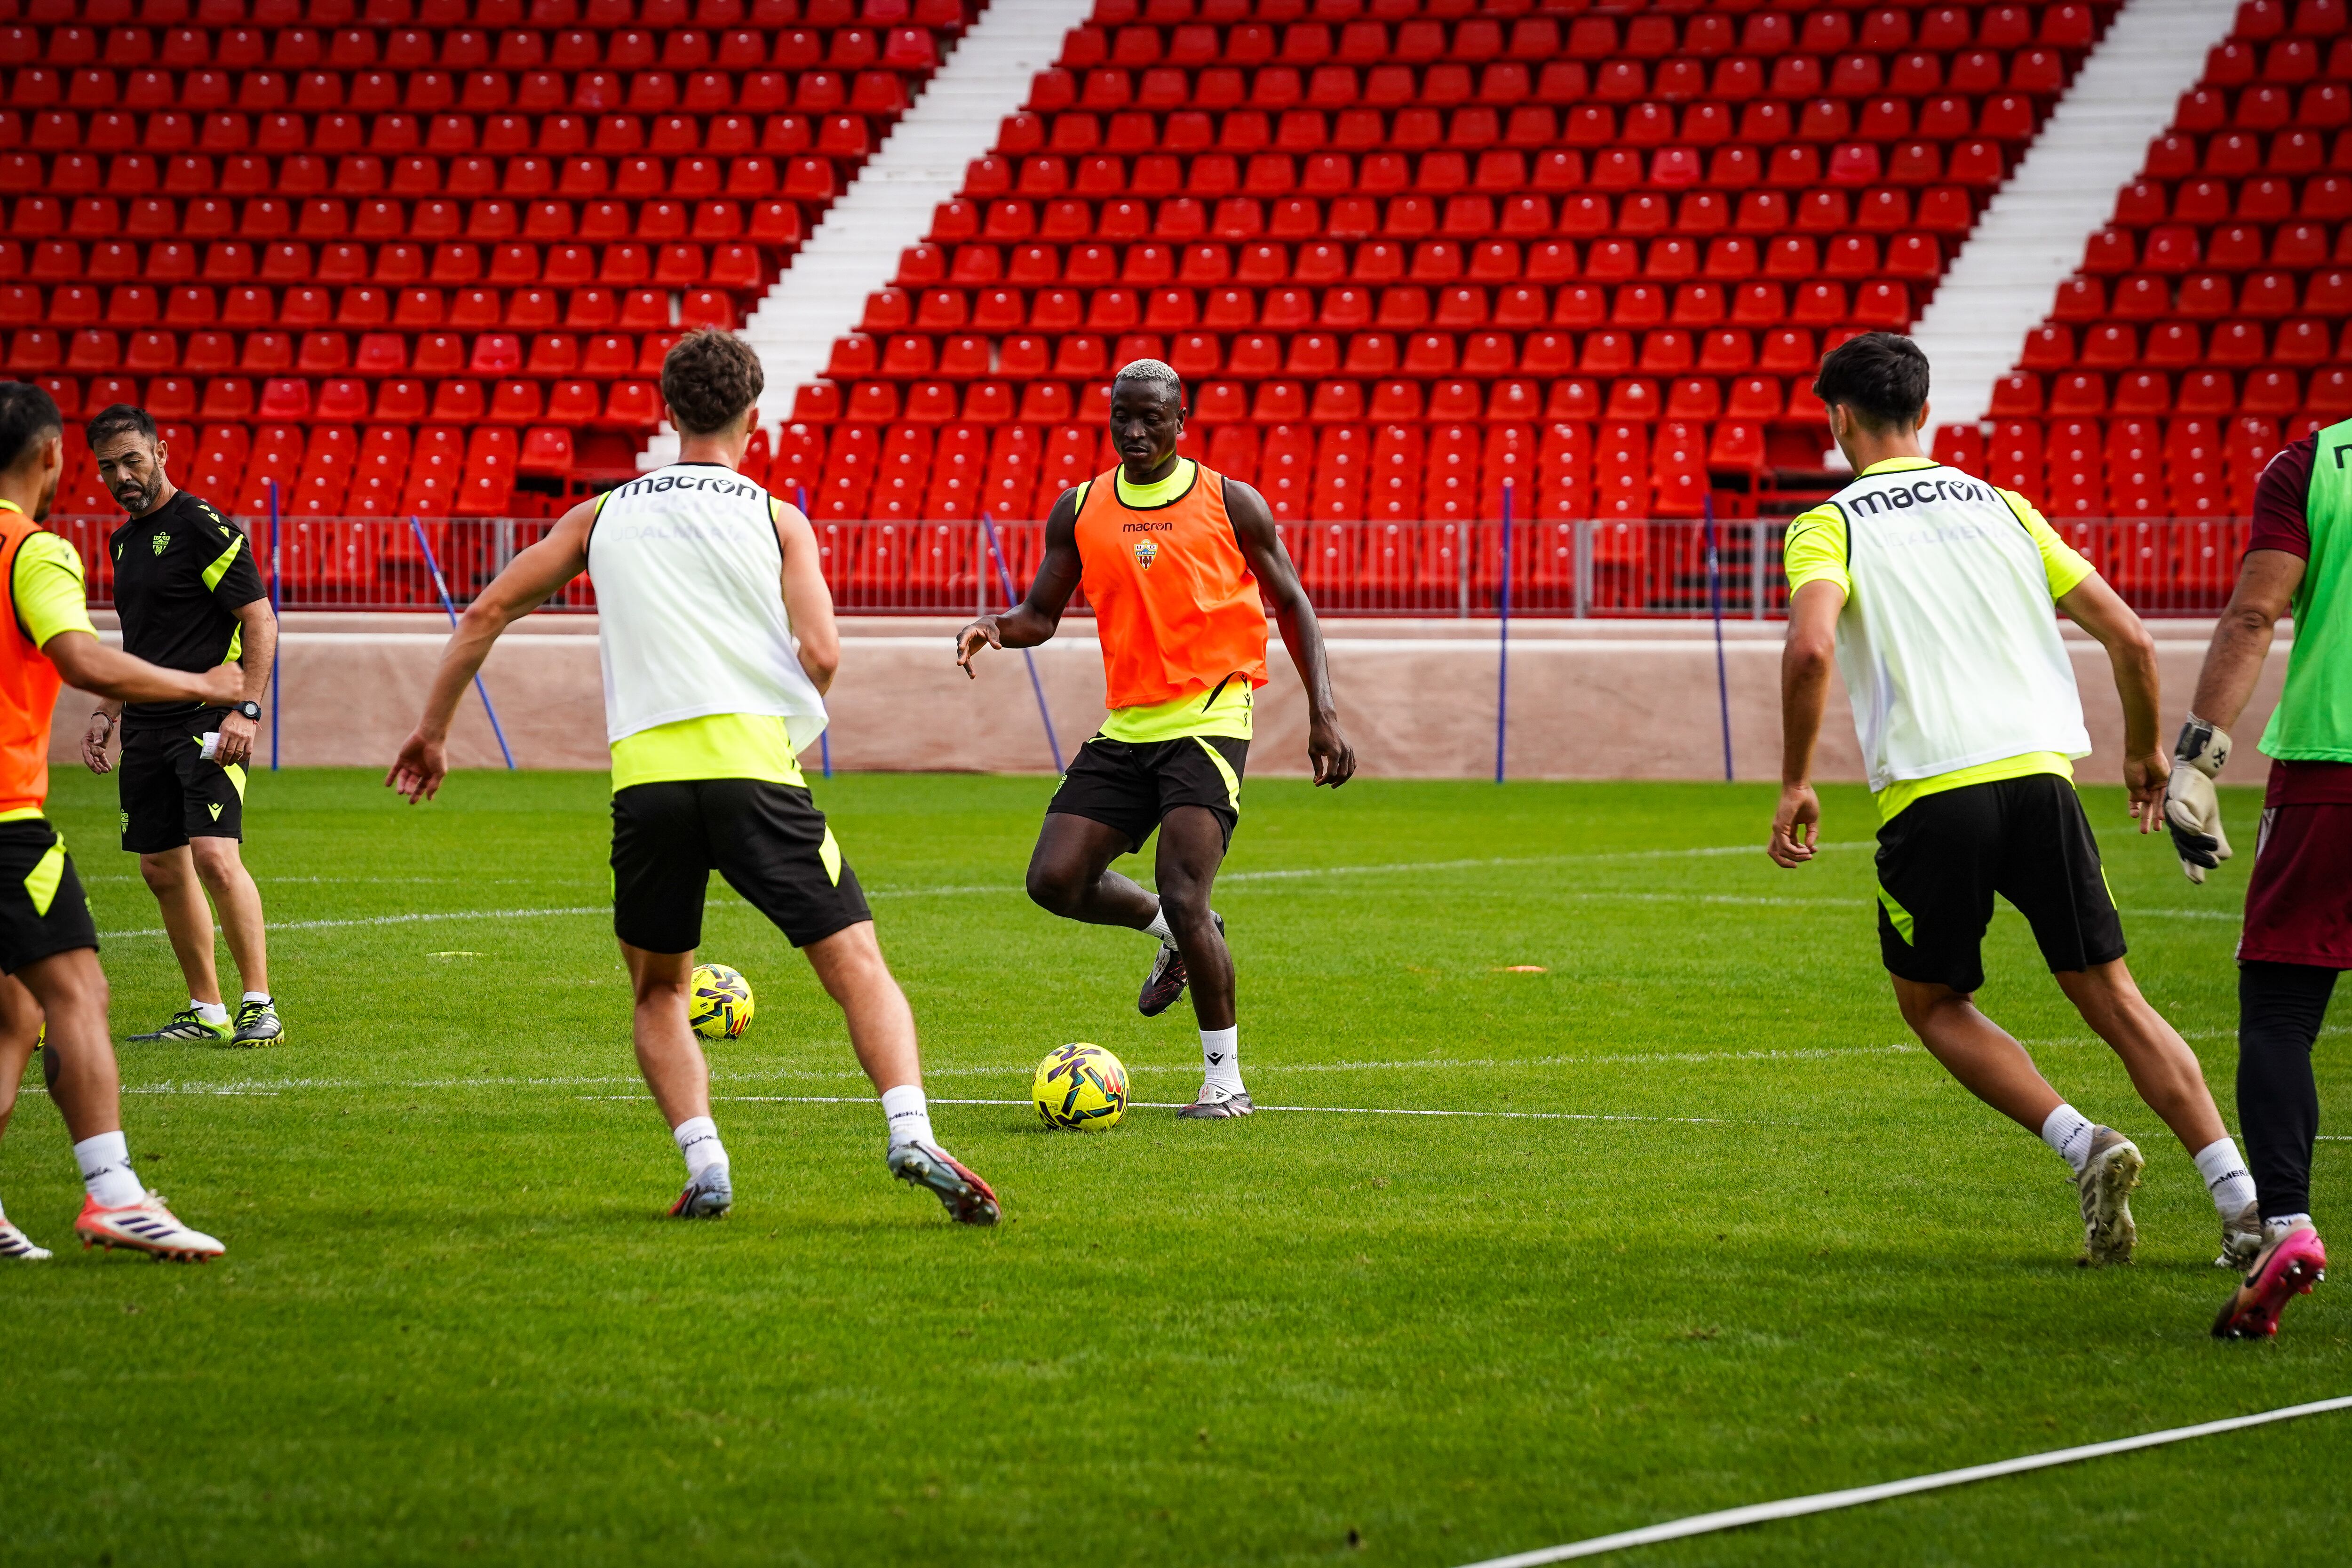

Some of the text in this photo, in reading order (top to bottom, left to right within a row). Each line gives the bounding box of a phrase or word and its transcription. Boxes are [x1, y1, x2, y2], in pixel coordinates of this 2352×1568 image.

[620, 476, 757, 501] macron
[1848, 480, 1995, 517] macron
[1123, 522, 1172, 532] macron
